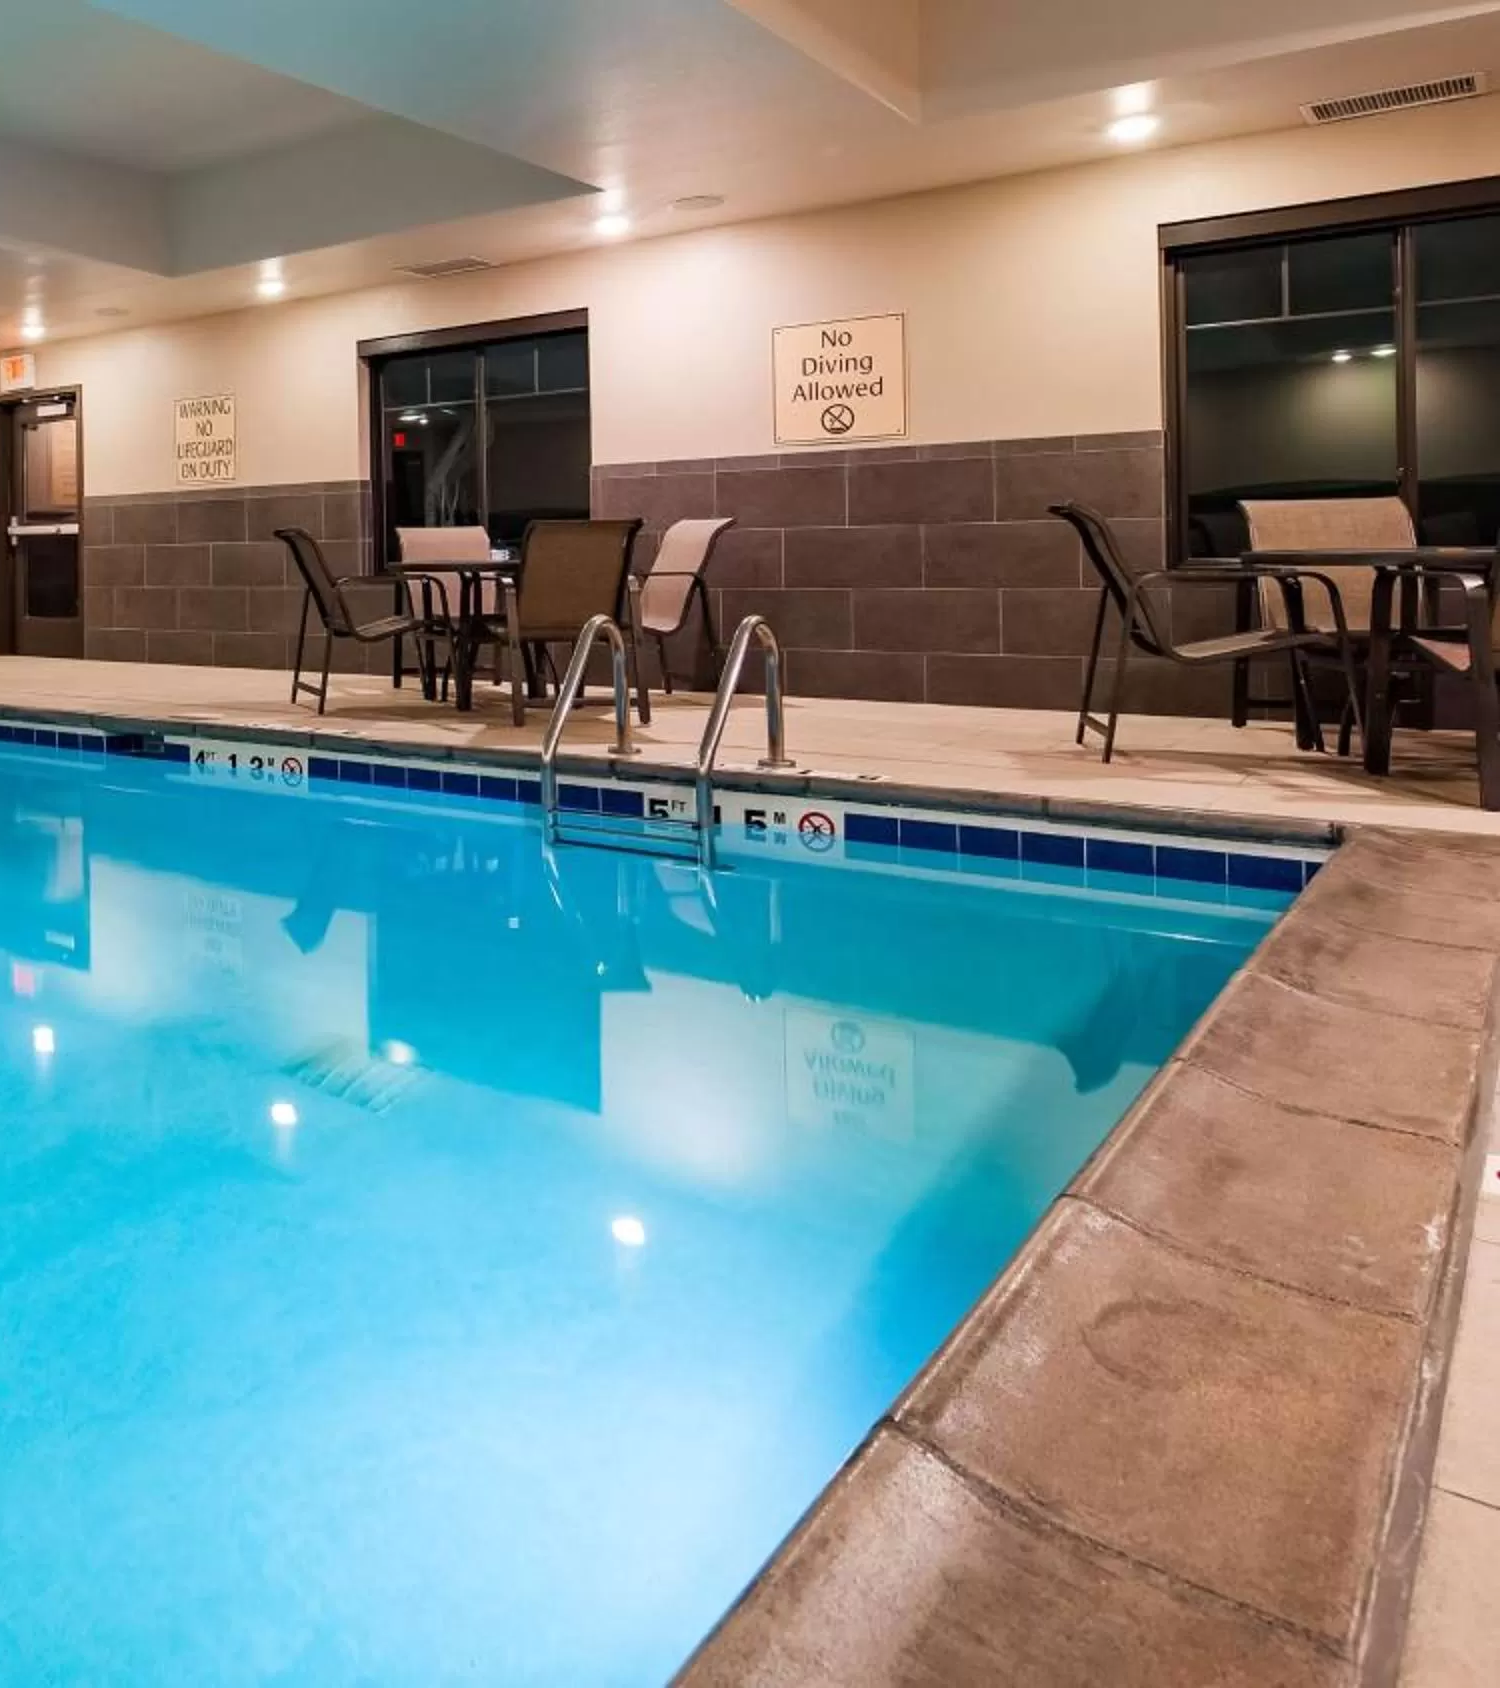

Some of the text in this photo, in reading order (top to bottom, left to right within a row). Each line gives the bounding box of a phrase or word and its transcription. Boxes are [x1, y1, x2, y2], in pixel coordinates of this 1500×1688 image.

[820, 329, 852, 348] No
[802, 352, 873, 376] Diving
[791, 375, 883, 402] Allowed
[195, 419, 213, 437] NO
